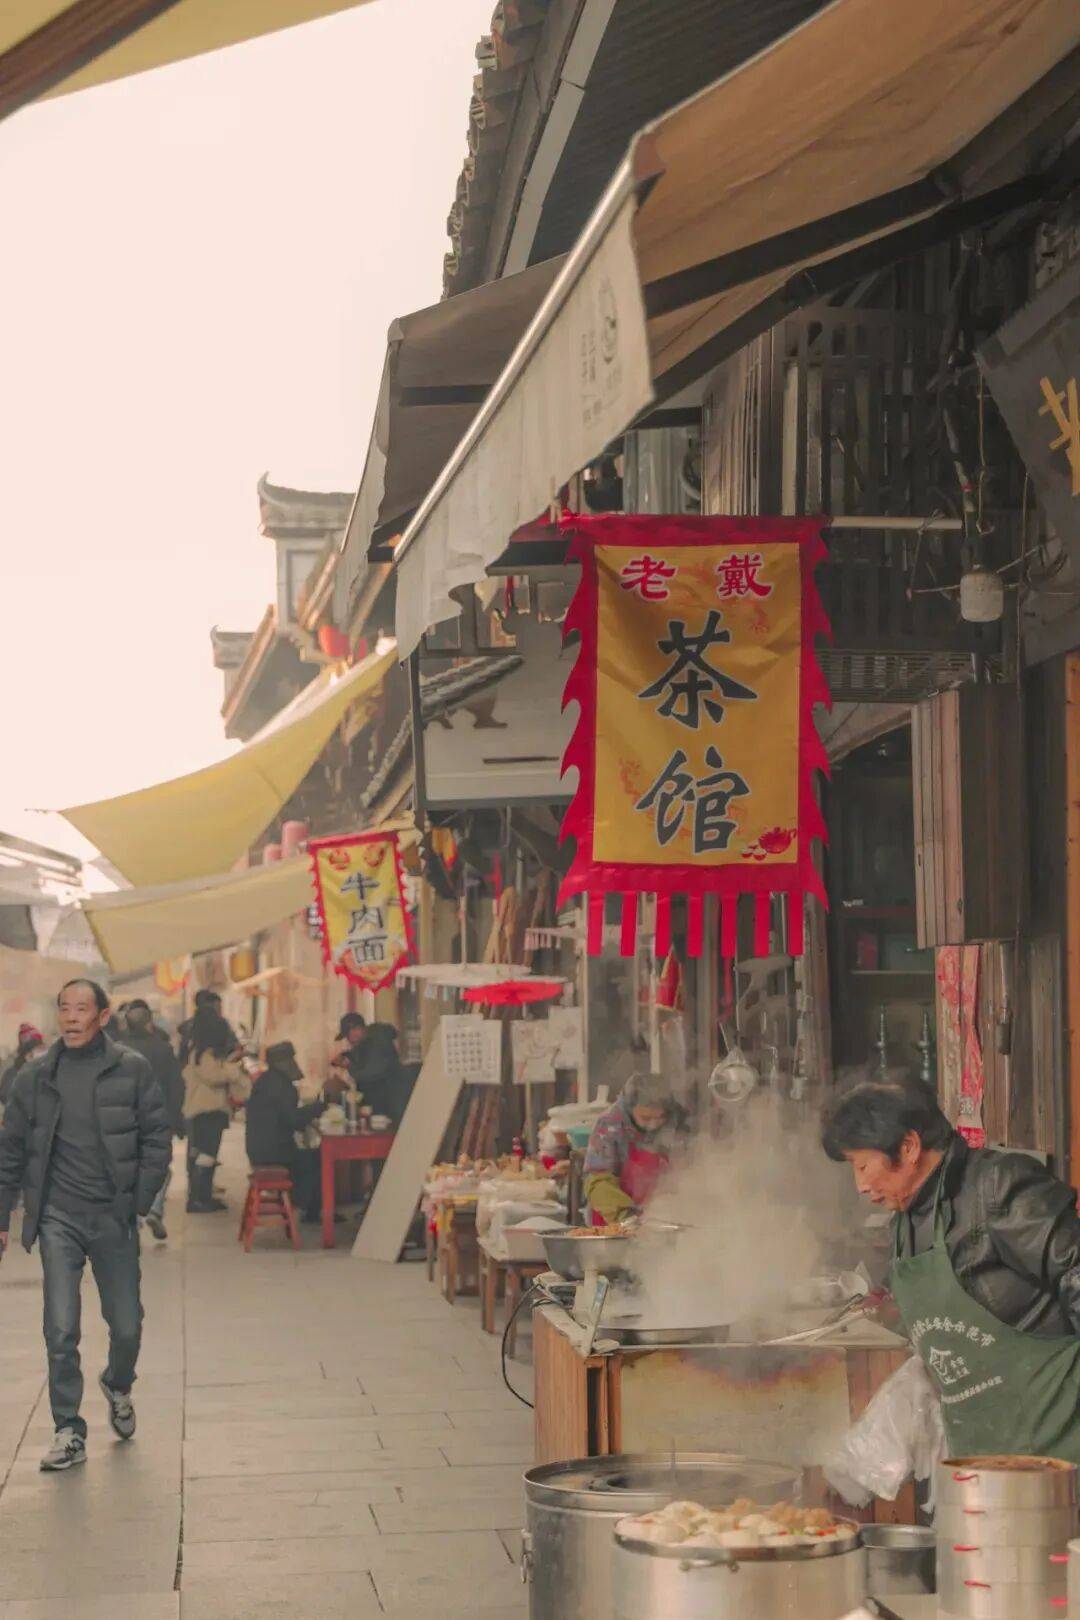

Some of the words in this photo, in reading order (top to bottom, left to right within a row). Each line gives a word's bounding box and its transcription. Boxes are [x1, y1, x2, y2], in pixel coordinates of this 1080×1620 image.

[636, 610, 758, 855] 茶馆
[340, 871, 389, 964] 牛肉面
